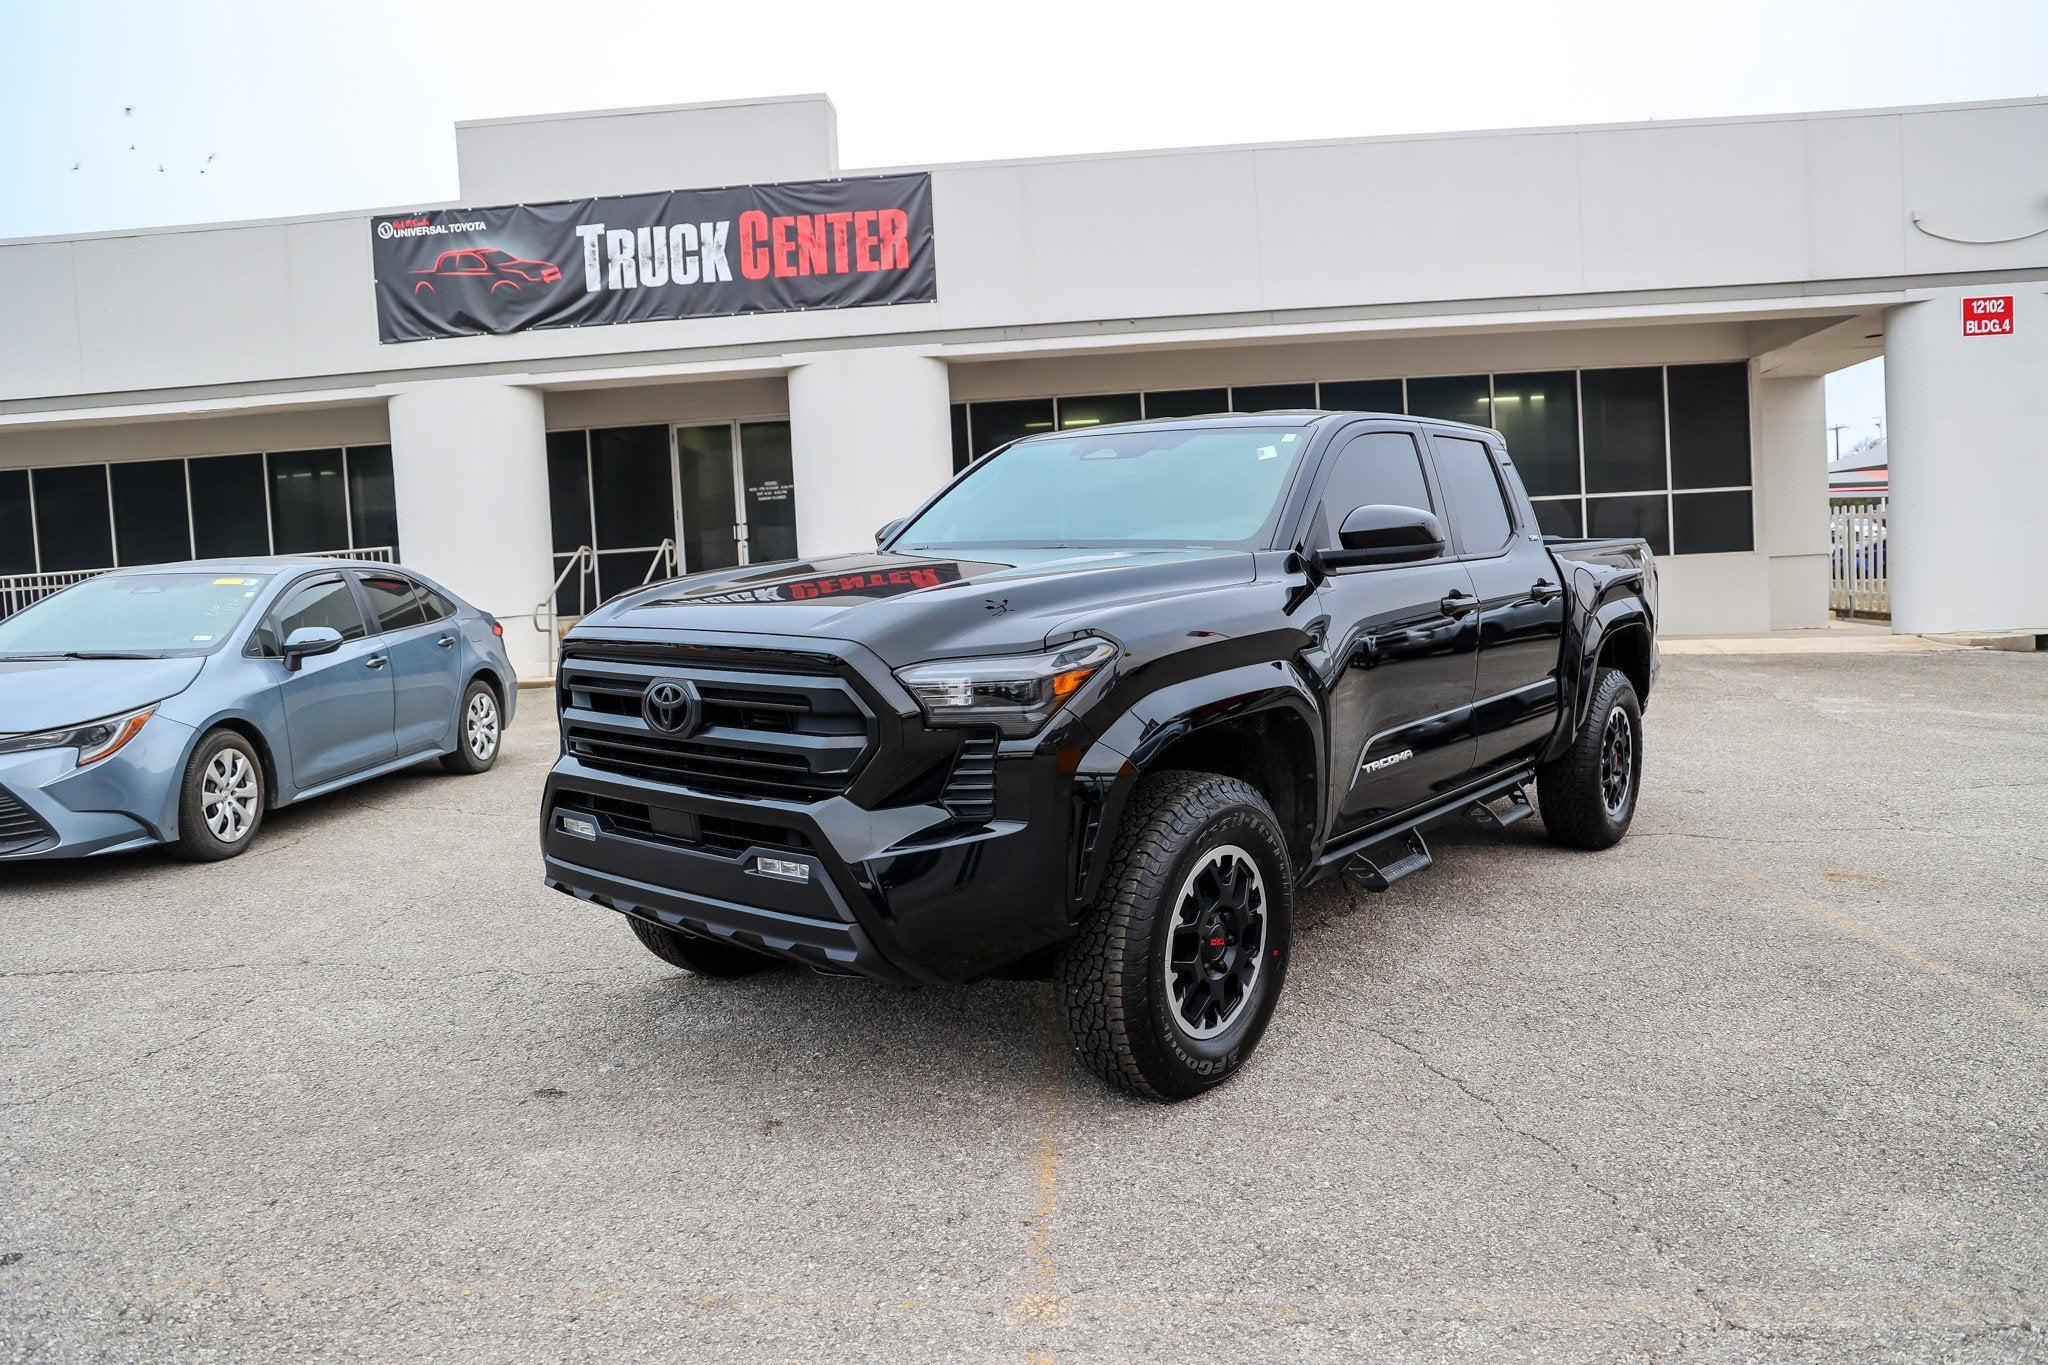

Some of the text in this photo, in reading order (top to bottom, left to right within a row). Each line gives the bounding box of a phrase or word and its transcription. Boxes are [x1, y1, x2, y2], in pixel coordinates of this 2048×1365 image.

[393, 221, 487, 239] UNIVERSAL TOYOTA
[575, 209, 910, 293] TRUCK CENTER
[1971, 299, 2005, 314] 12102
[1361, 749, 1414, 773] TACOMA
